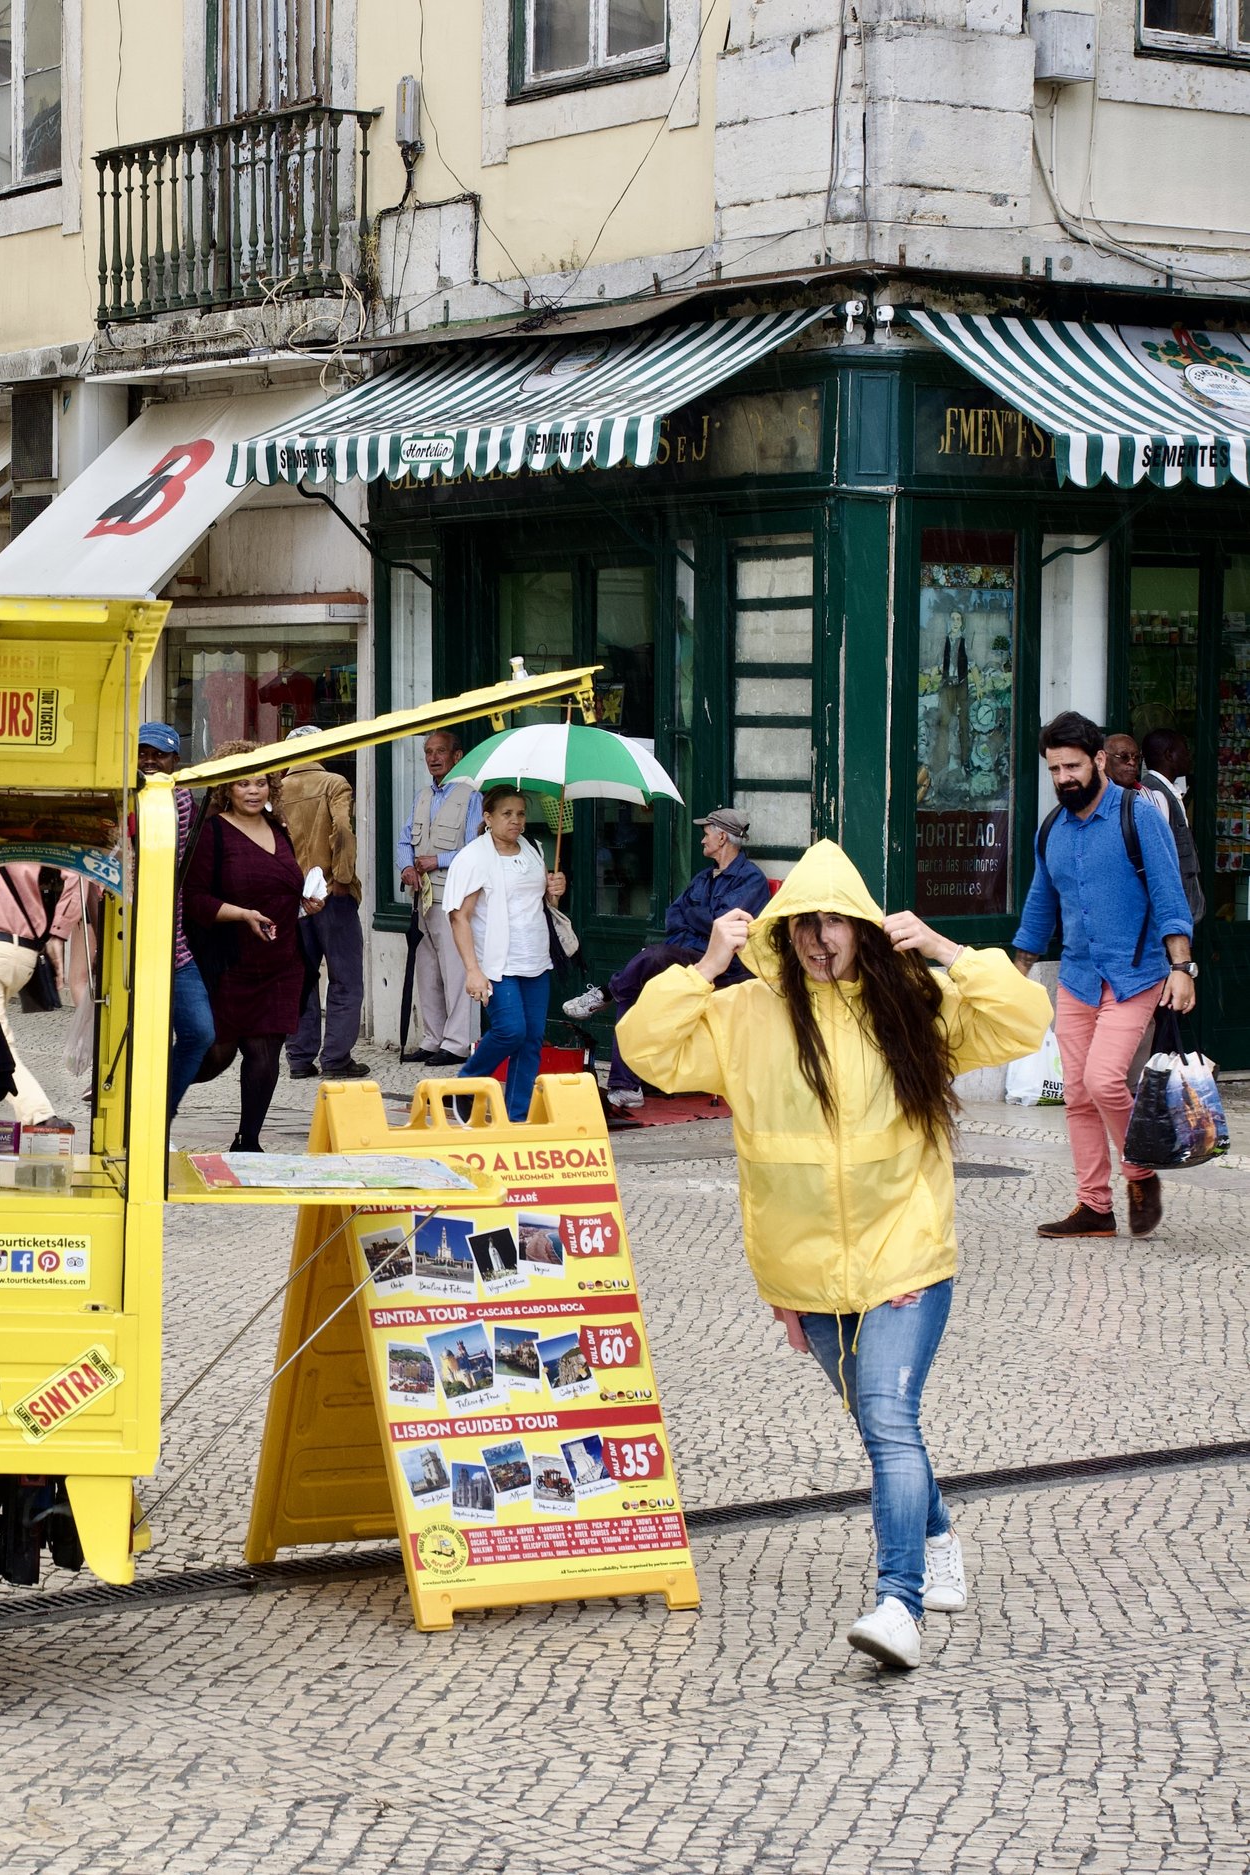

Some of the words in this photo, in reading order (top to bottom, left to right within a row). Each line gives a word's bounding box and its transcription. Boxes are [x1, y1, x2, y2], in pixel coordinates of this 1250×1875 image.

[526, 430, 595, 455] SEMENTES
[280, 447, 335, 469] SEMENTES
[1141, 445, 1229, 468] SEMENTES
[39, 708, 54, 742] TICKETS
[926, 879, 982, 897] Sementes
[1041, 1089, 1059, 1099] ESTE
[493, 1153, 510, 1172] A
[514, 1147, 608, 1171] LISBOA!
[501, 1173, 555, 1182] WILLKOMMEN
[561, 1170, 609, 1179] BENVENUTO
[566, 1219, 575, 1236] DAY
[579, 1218, 602, 1226] FROM
[569, 1237, 579, 1254] FULL
[579, 1226, 612, 1255] 64€
[374, 1309, 426, 1326] SINTRA
[427, 1306, 468, 1322] TOUR
[476, 1306, 513, 1317] CASCAIS
[513, 1305, 521, 1315] &
[521, 1304, 547, 1314] CABO
[547, 1303, 559, 1313] DA
[559, 1302, 585, 1313] ROCA
[585, 1329, 595, 1347] DAY
[599, 1328, 622, 1336] FROM
[591, 1348, 600, 1365] FULL
[600, 1336, 633, 1365] 60€
[28, 1362, 106, 1428] SINTRA
[394, 1421, 451, 1439] LISBON
[454, 1418, 513, 1436] GUIDED
[516, 1414, 559, 1430] TOUR
[607, 1441, 616, 1459] DAY
[613, 1459, 622, 1478] HALF
[621, 1442, 659, 1478] 35€
[469, 1530, 488, 1538] PRIVATE
[490, 1529, 506, 1537] TOURS
[538, 1524, 564, 1533] TRANSFERS
[591, 1521, 610, 1529] PICK-UP
[497, 1536, 518, 1544] ELECTRIC
[590, 1528, 610, 1536] CRUISES
[471, 1545, 493, 1554] WALKING
[496, 1544, 512, 1552] TOURS
[523, 1541, 550, 1550] HELICOPTER
[553, 1539, 568, 1547] TOURS
[633, 1532, 659, 1541] APARTMENT
[662, 1530, 682, 1539] RENTALS
